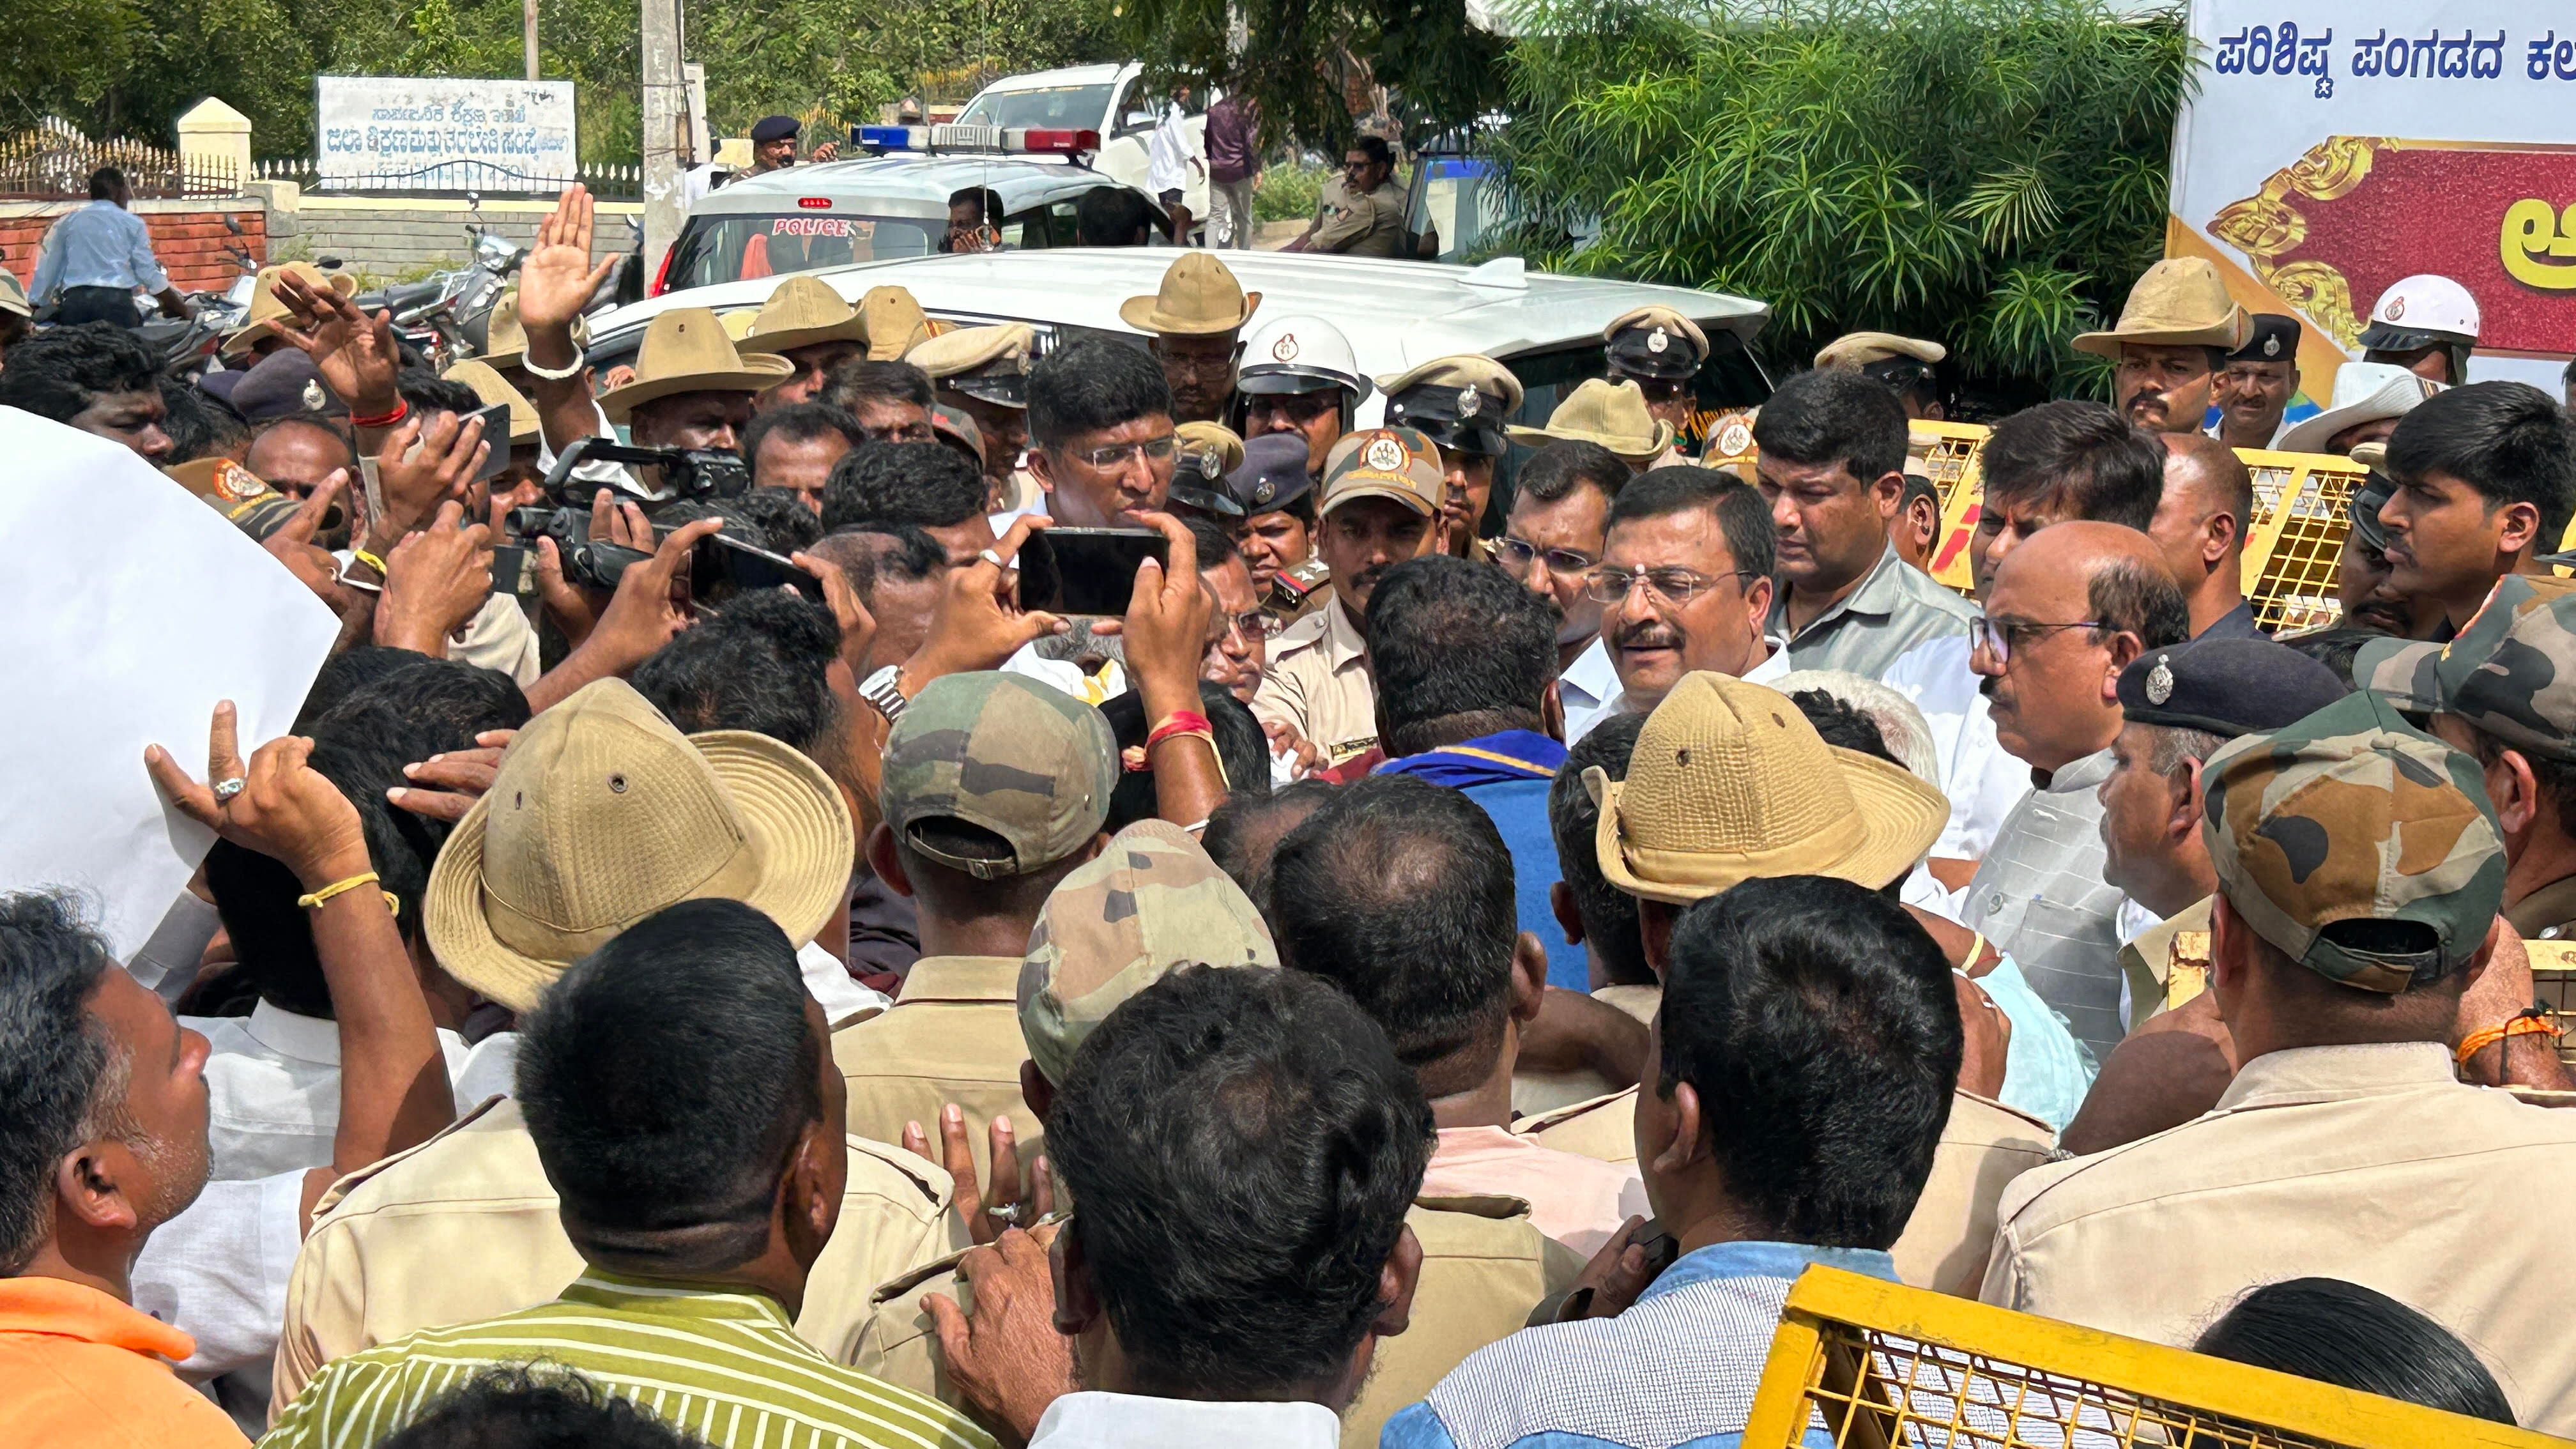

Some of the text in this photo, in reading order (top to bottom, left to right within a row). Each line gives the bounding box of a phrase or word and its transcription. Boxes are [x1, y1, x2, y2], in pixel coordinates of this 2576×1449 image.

[2216, 21, 2334, 99] ಪರಿಶಿಷ್ಟ
[2352, 29, 2505, 79] ಪಂಗಡದ
[772, 218, 851, 237] POLICE
